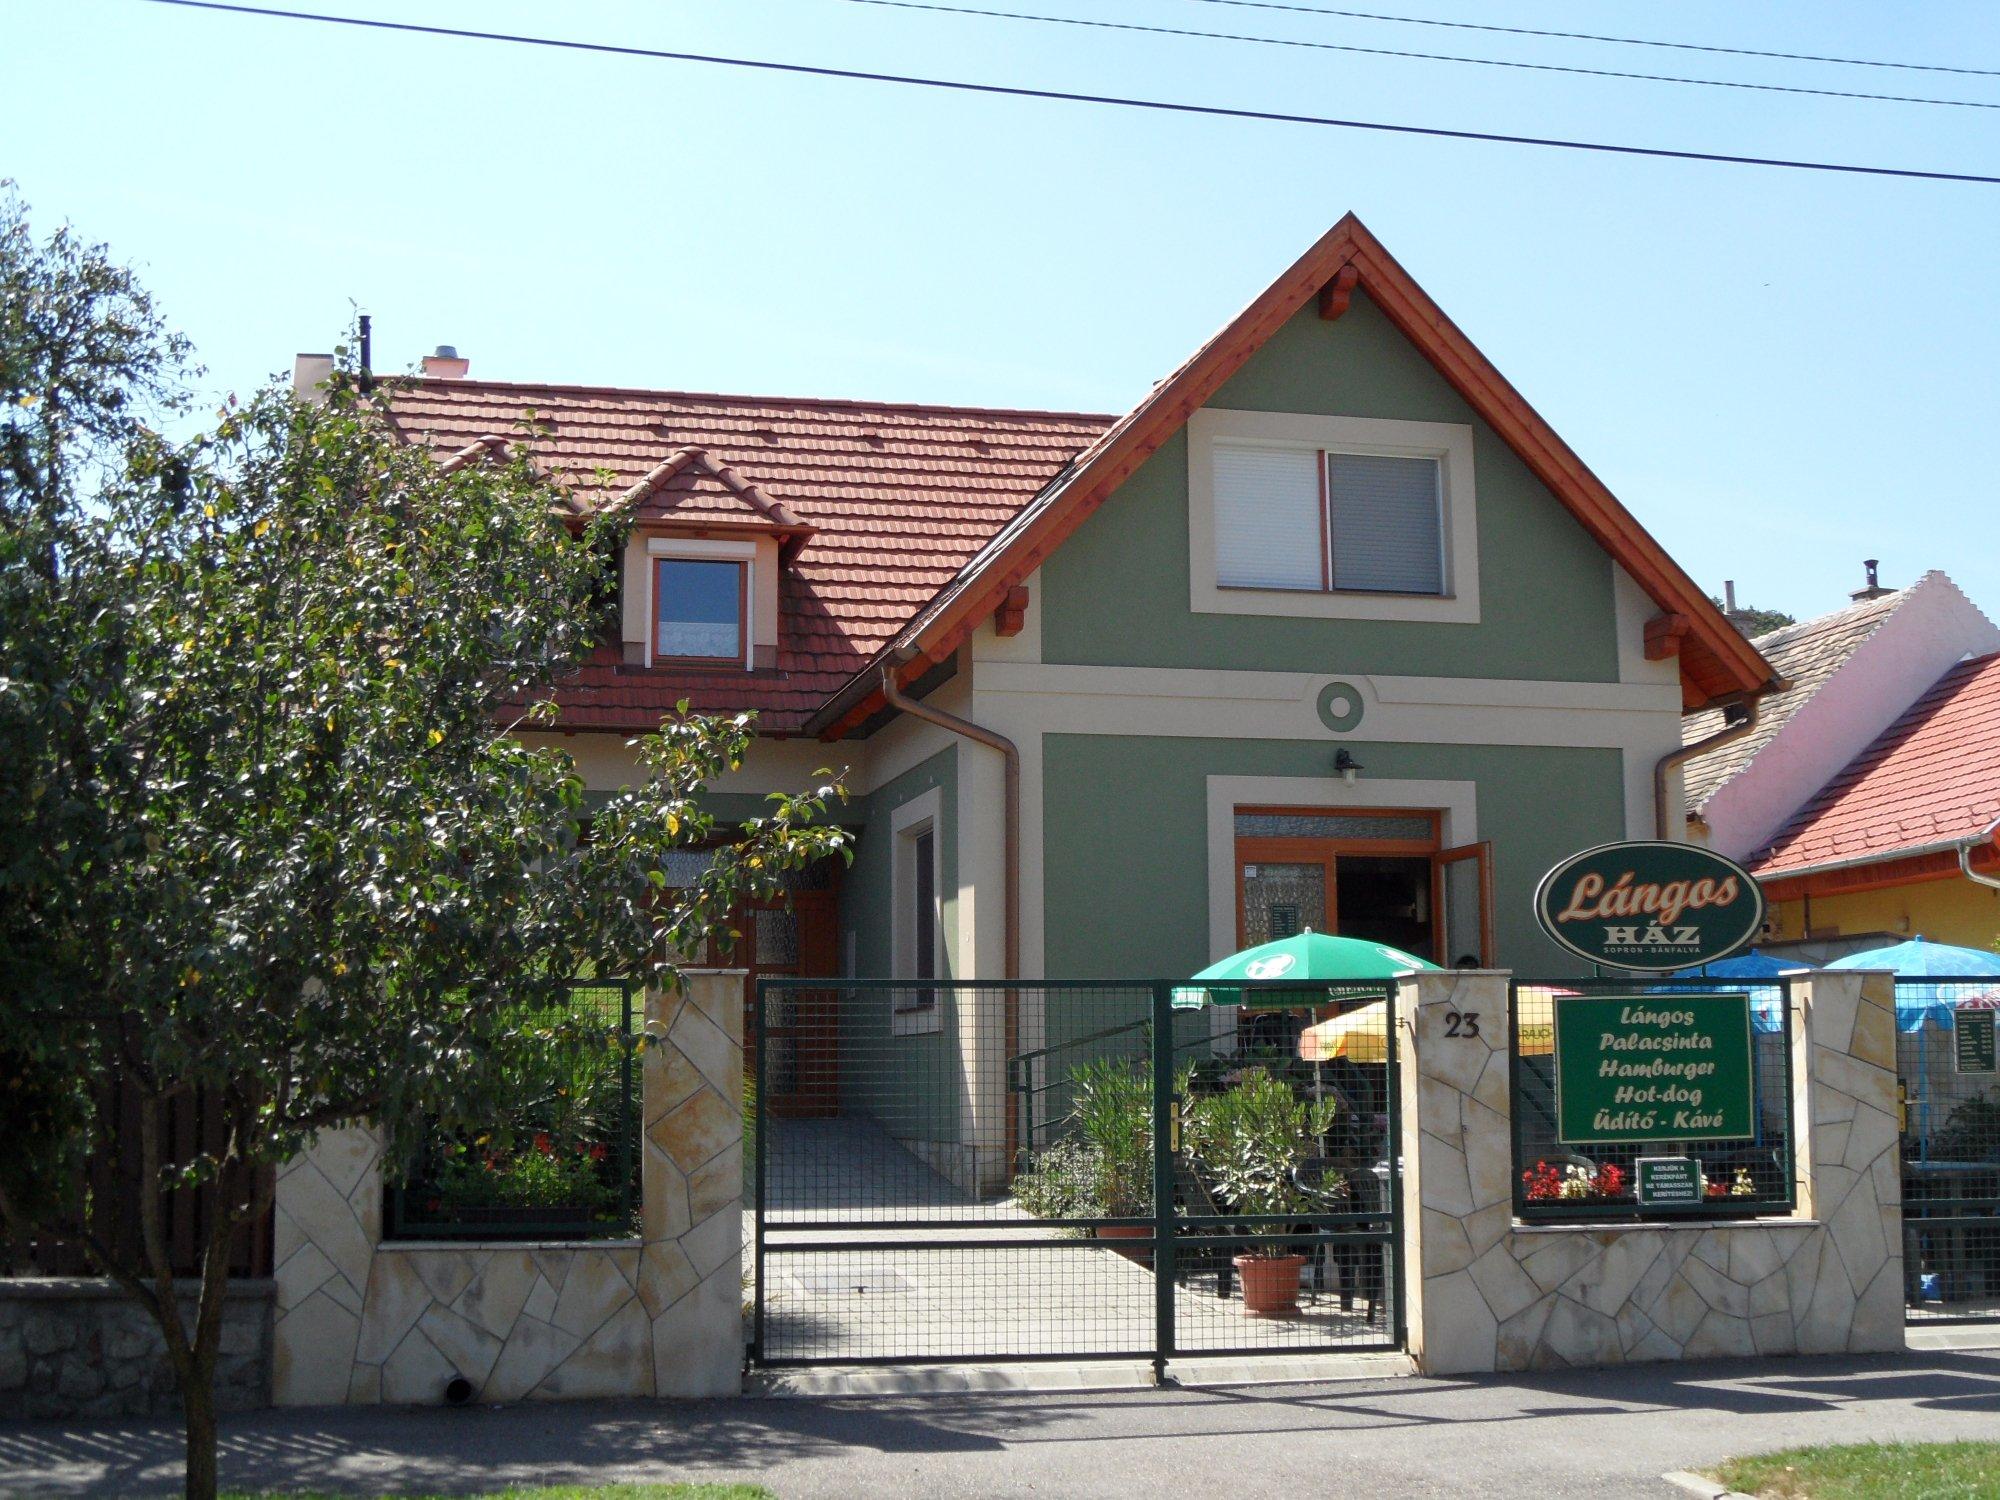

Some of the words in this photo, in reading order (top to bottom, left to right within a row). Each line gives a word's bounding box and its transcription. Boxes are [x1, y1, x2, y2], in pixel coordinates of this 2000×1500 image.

[1557, 871, 1740, 926] Lángos
[1602, 919, 1700, 944] HÁZ
[1444, 1012, 1480, 1038] 23
[1620, 1005, 1695, 1028] Lángos
[1599, 1032, 1713, 1051] Palacsinta
[1598, 1058, 1715, 1080] Hamburger
[1614, 1084, 1702, 1106] Hot-dog
[1593, 1108, 1658, 1130] Üdítő
[1673, 1108, 1724, 1129] Kávé
